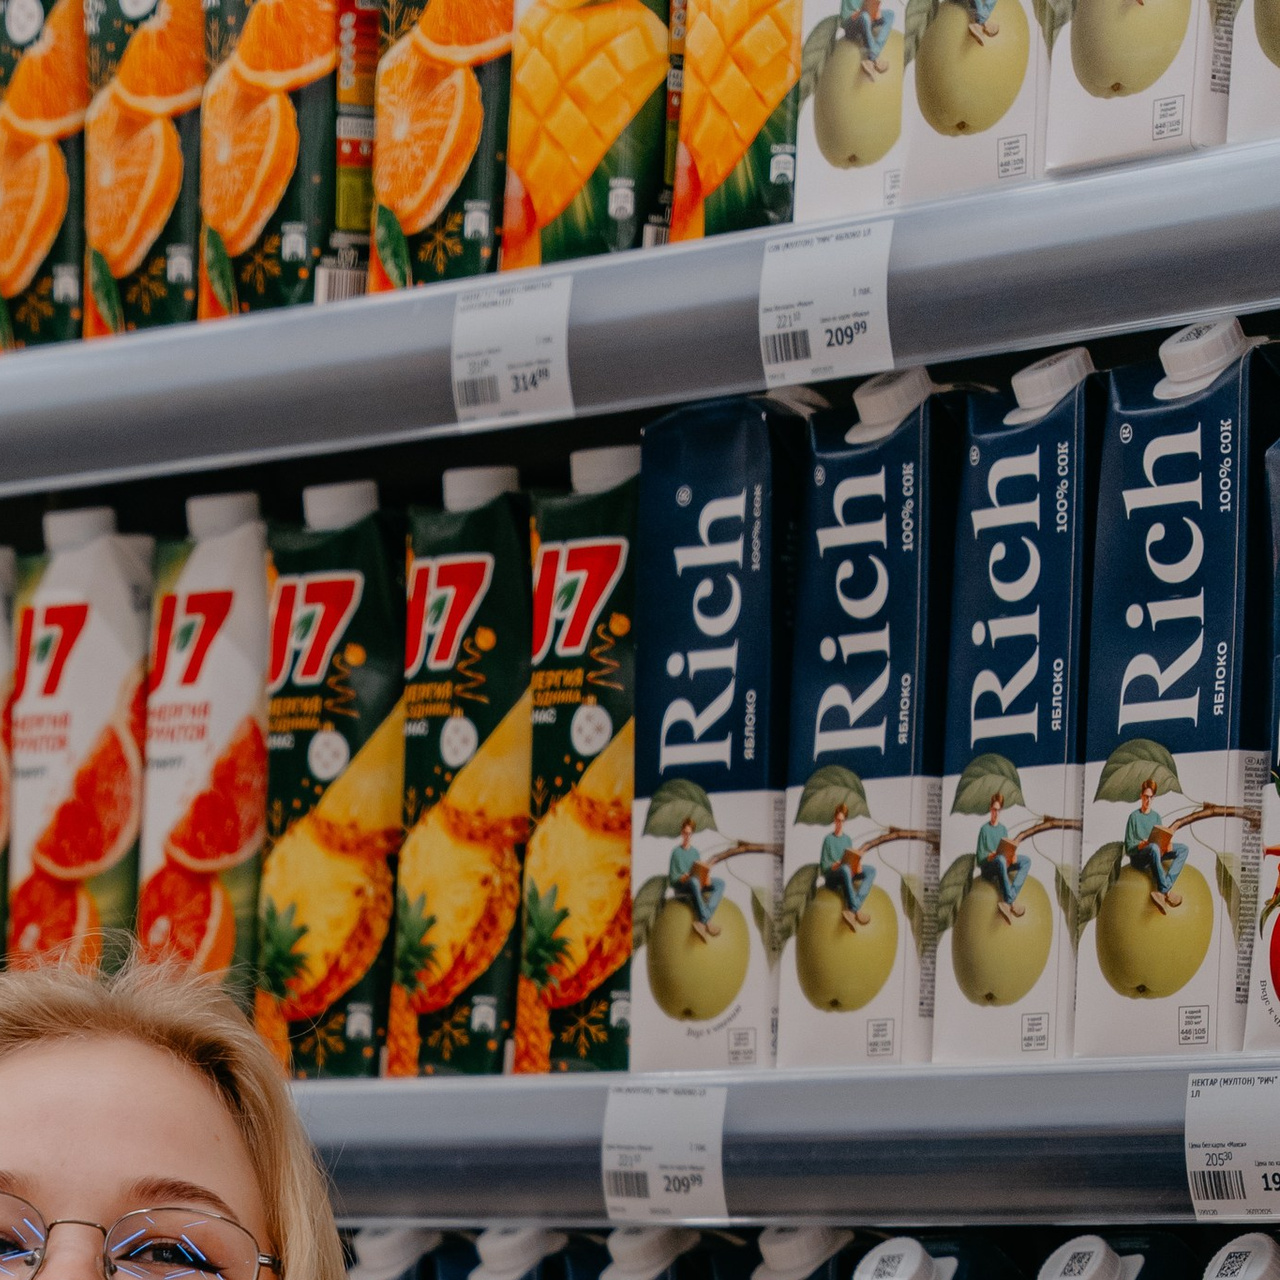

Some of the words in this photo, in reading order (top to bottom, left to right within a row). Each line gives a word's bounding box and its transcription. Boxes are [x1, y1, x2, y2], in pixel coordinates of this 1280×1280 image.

[1056, 479, 1069, 533] 100%
[1219, 457, 1232, 513] 100%
[901, 498, 914, 552] 100%
[813, 464, 891, 762] Rich
[970, 444, 1041, 749] Rich
[1117, 421, 1204, 735] Rich
[659, 486, 747, 775] Rich
[898, 672, 911, 745] ЯБЛОКО
[1051, 658, 1064, 731] ЯБЛОКО
[1213, 641, 1228, 716] ЯБЛОКО
[744, 689, 757, 760] ЯБЛОКО
[1191, 1078, 1218, 1087] НЕКТАР
[1220, 1077, 1255, 1088] (МУЛТОН)
